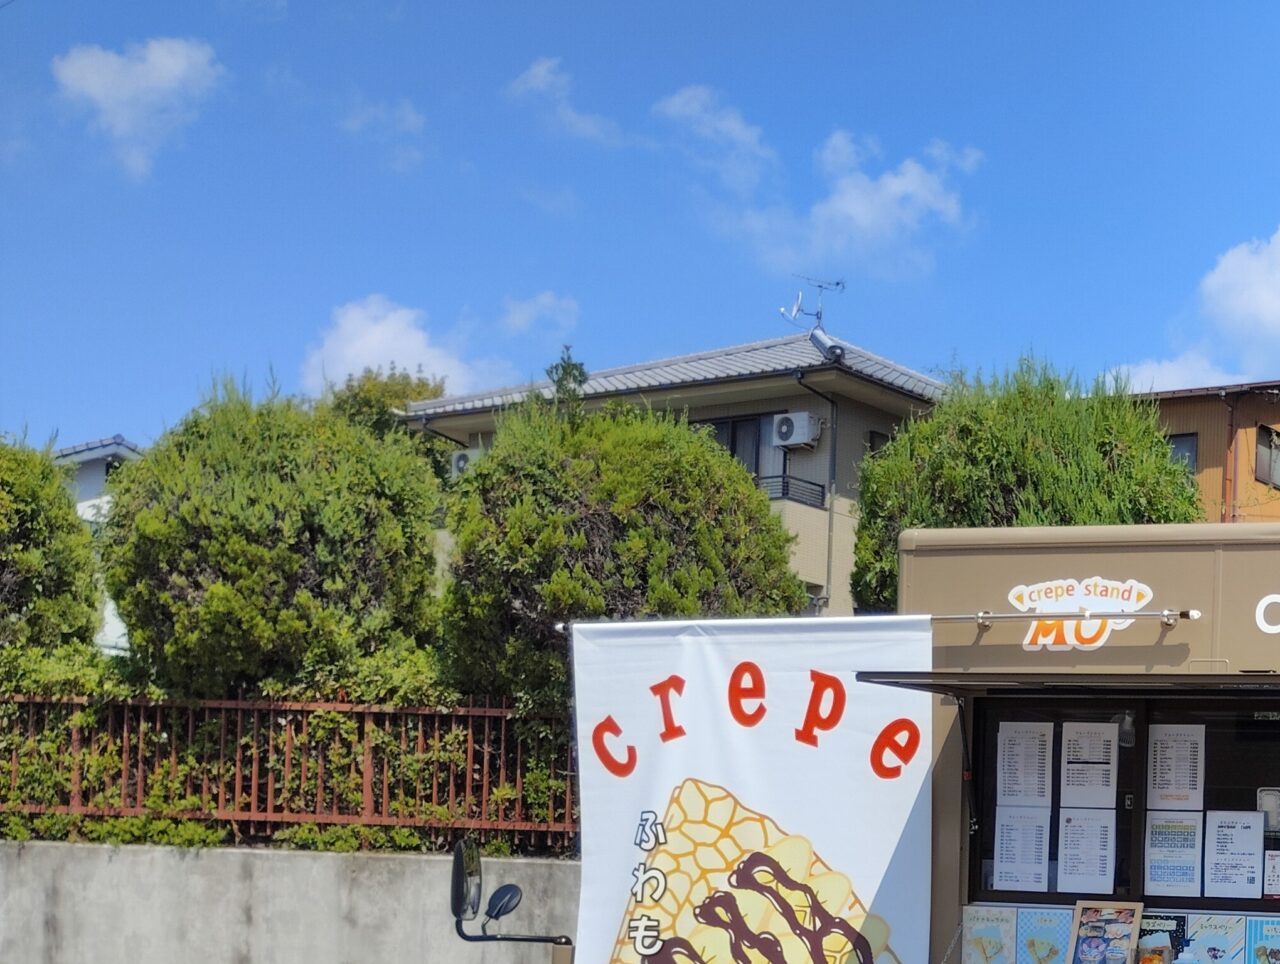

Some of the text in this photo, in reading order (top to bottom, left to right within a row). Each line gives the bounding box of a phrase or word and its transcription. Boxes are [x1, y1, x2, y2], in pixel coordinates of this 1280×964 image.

[1028, 582, 1134, 603] crepe stand
[591, 661, 921, 778] crepe
